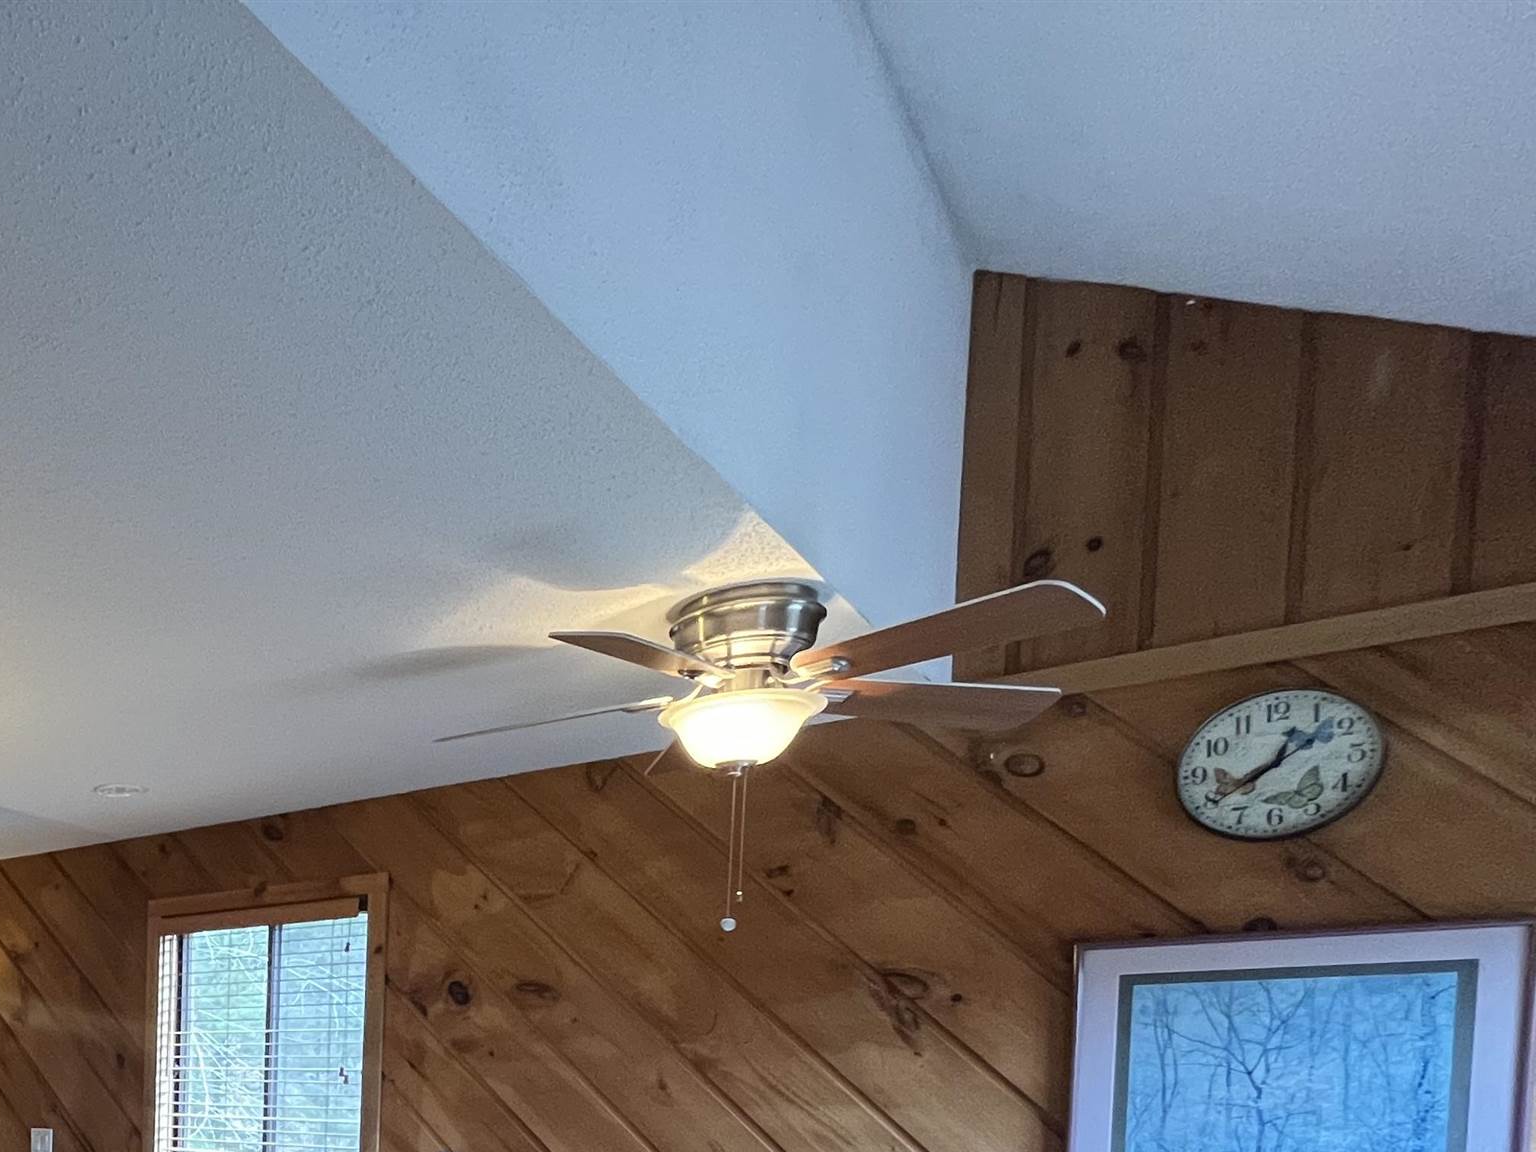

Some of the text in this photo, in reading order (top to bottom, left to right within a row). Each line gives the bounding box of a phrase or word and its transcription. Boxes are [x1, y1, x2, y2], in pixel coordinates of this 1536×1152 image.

[1266, 701, 1291, 723] 12
[1314, 703, 1320, 723] 1
[1235, 715, 1251, 736] 11
[1337, 717, 1355, 736] 2
[1206, 736, 1230, 758] 10
[1191, 766, 1208, 786] 9
[1331, 772, 1353, 793] 4
[1231, 805, 1249, 825] 7
[1266, 807, 1284, 827] 6
